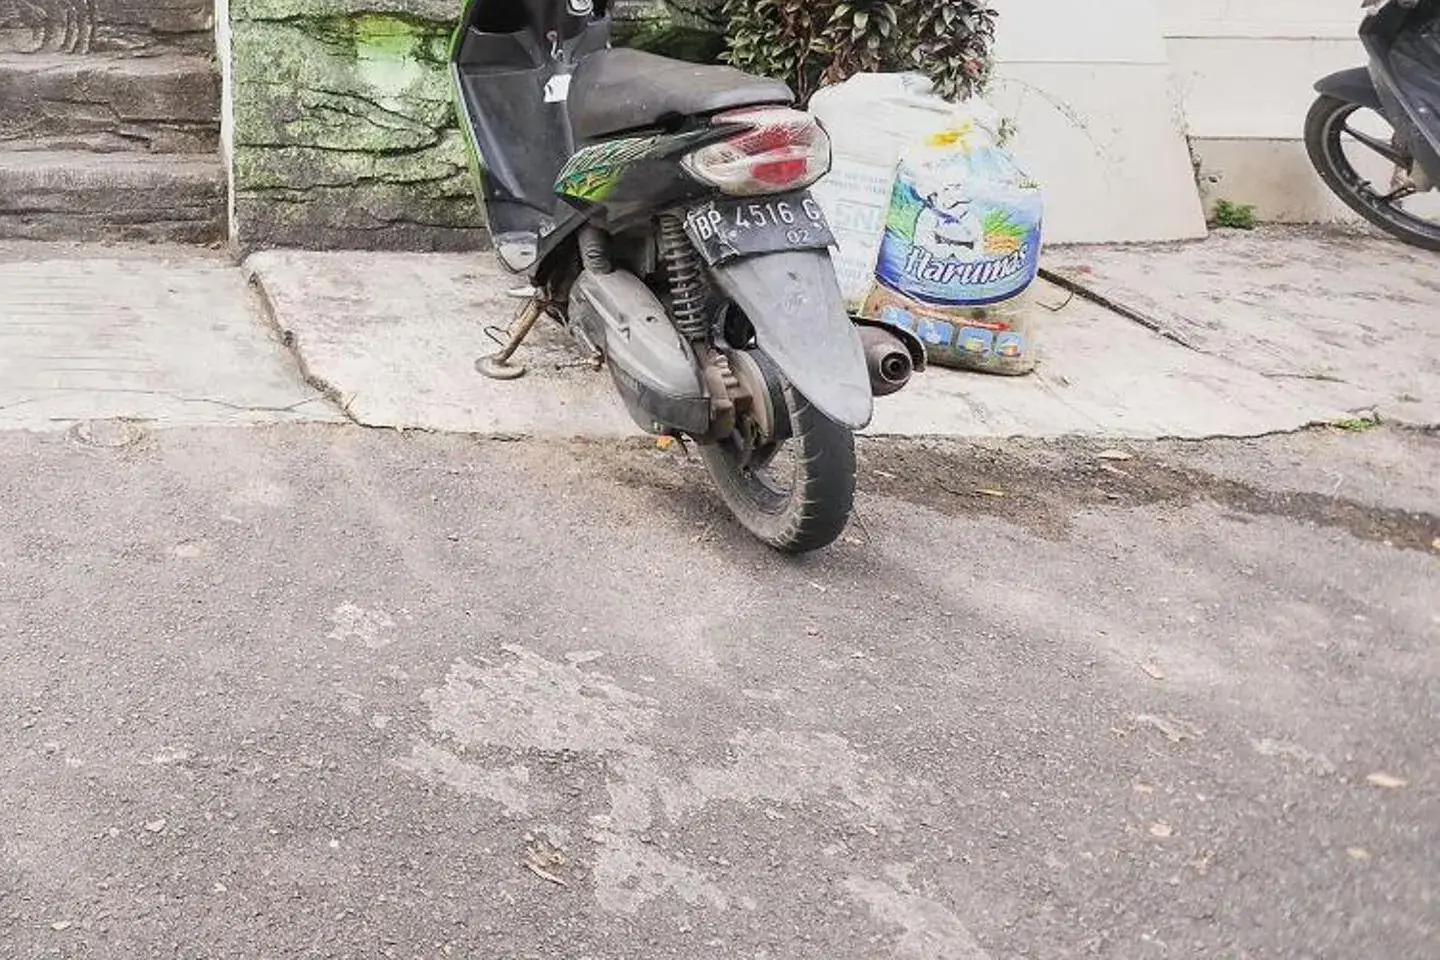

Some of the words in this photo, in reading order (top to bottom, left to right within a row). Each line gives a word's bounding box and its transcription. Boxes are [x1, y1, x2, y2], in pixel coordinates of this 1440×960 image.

[697, 210, 721, 240] BP
[736, 202, 795, 228] 4516
[802, 198, 820, 221] G
[903, 244, 1028, 284] Harumas
